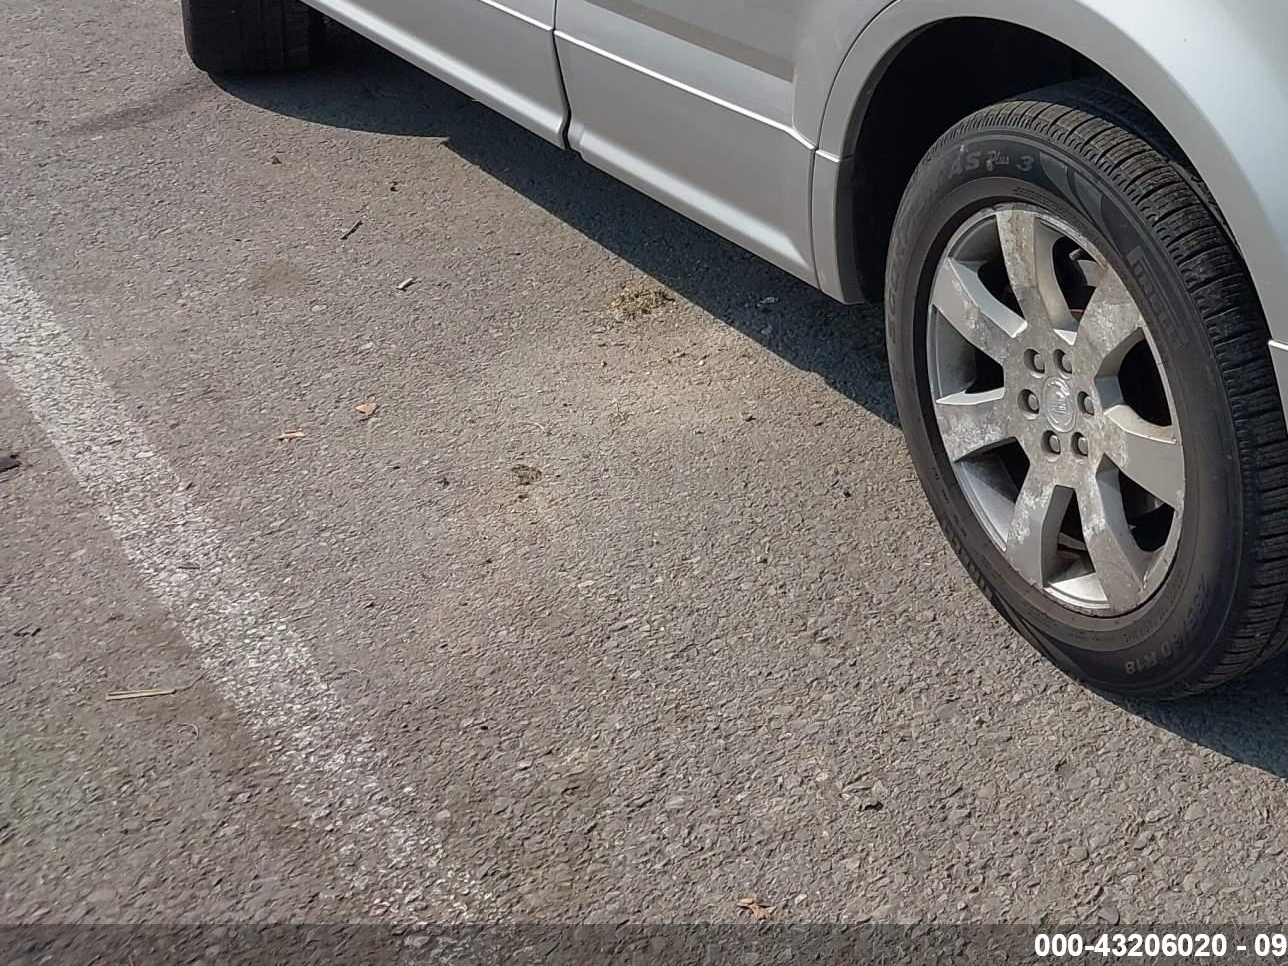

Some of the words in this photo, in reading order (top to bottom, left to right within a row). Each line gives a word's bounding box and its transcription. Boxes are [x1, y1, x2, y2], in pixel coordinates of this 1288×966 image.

[985, 150, 1010, 172] Plus
[1016, 155, 1035, 172] 3
[1124, 651, 1157, 675] R18
